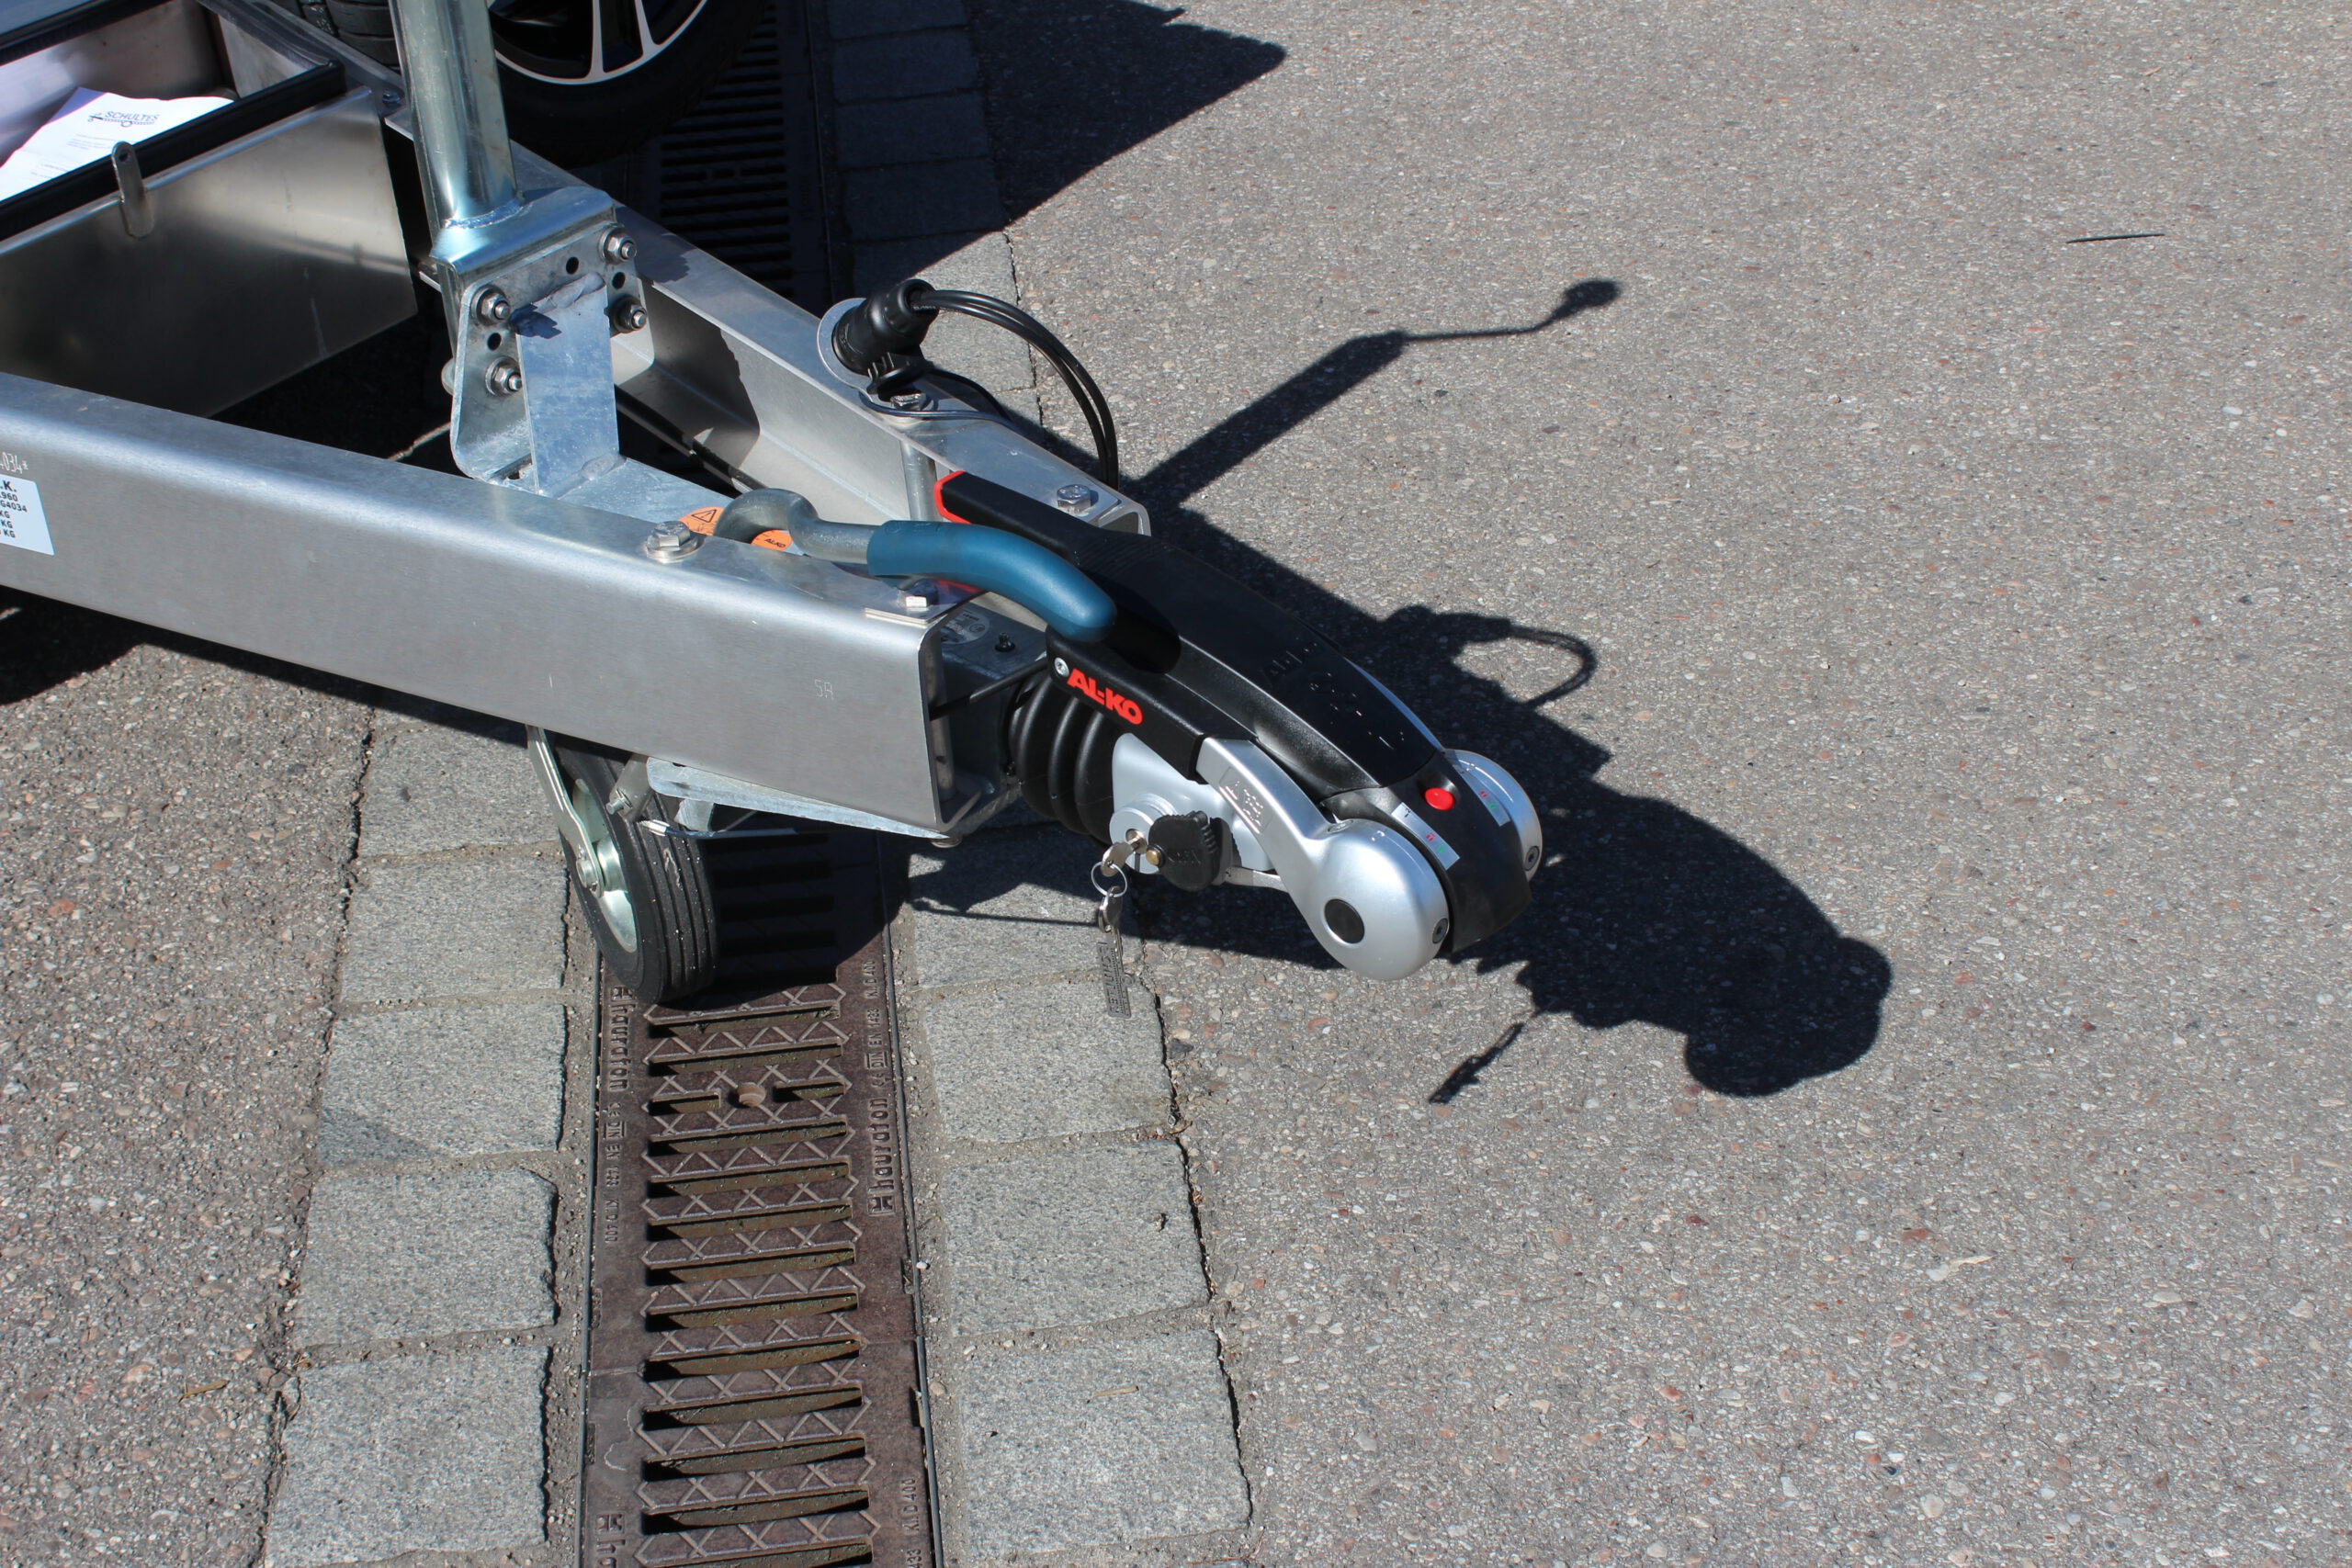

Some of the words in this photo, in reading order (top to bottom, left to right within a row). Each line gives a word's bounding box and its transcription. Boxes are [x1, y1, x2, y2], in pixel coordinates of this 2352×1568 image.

[104, 110, 160, 122] SCHULTES
[1067, 668, 1143, 725] AL-KO
[609, 1003, 636, 1090] hauraton
[868, 1098, 895, 1191] hauraton
